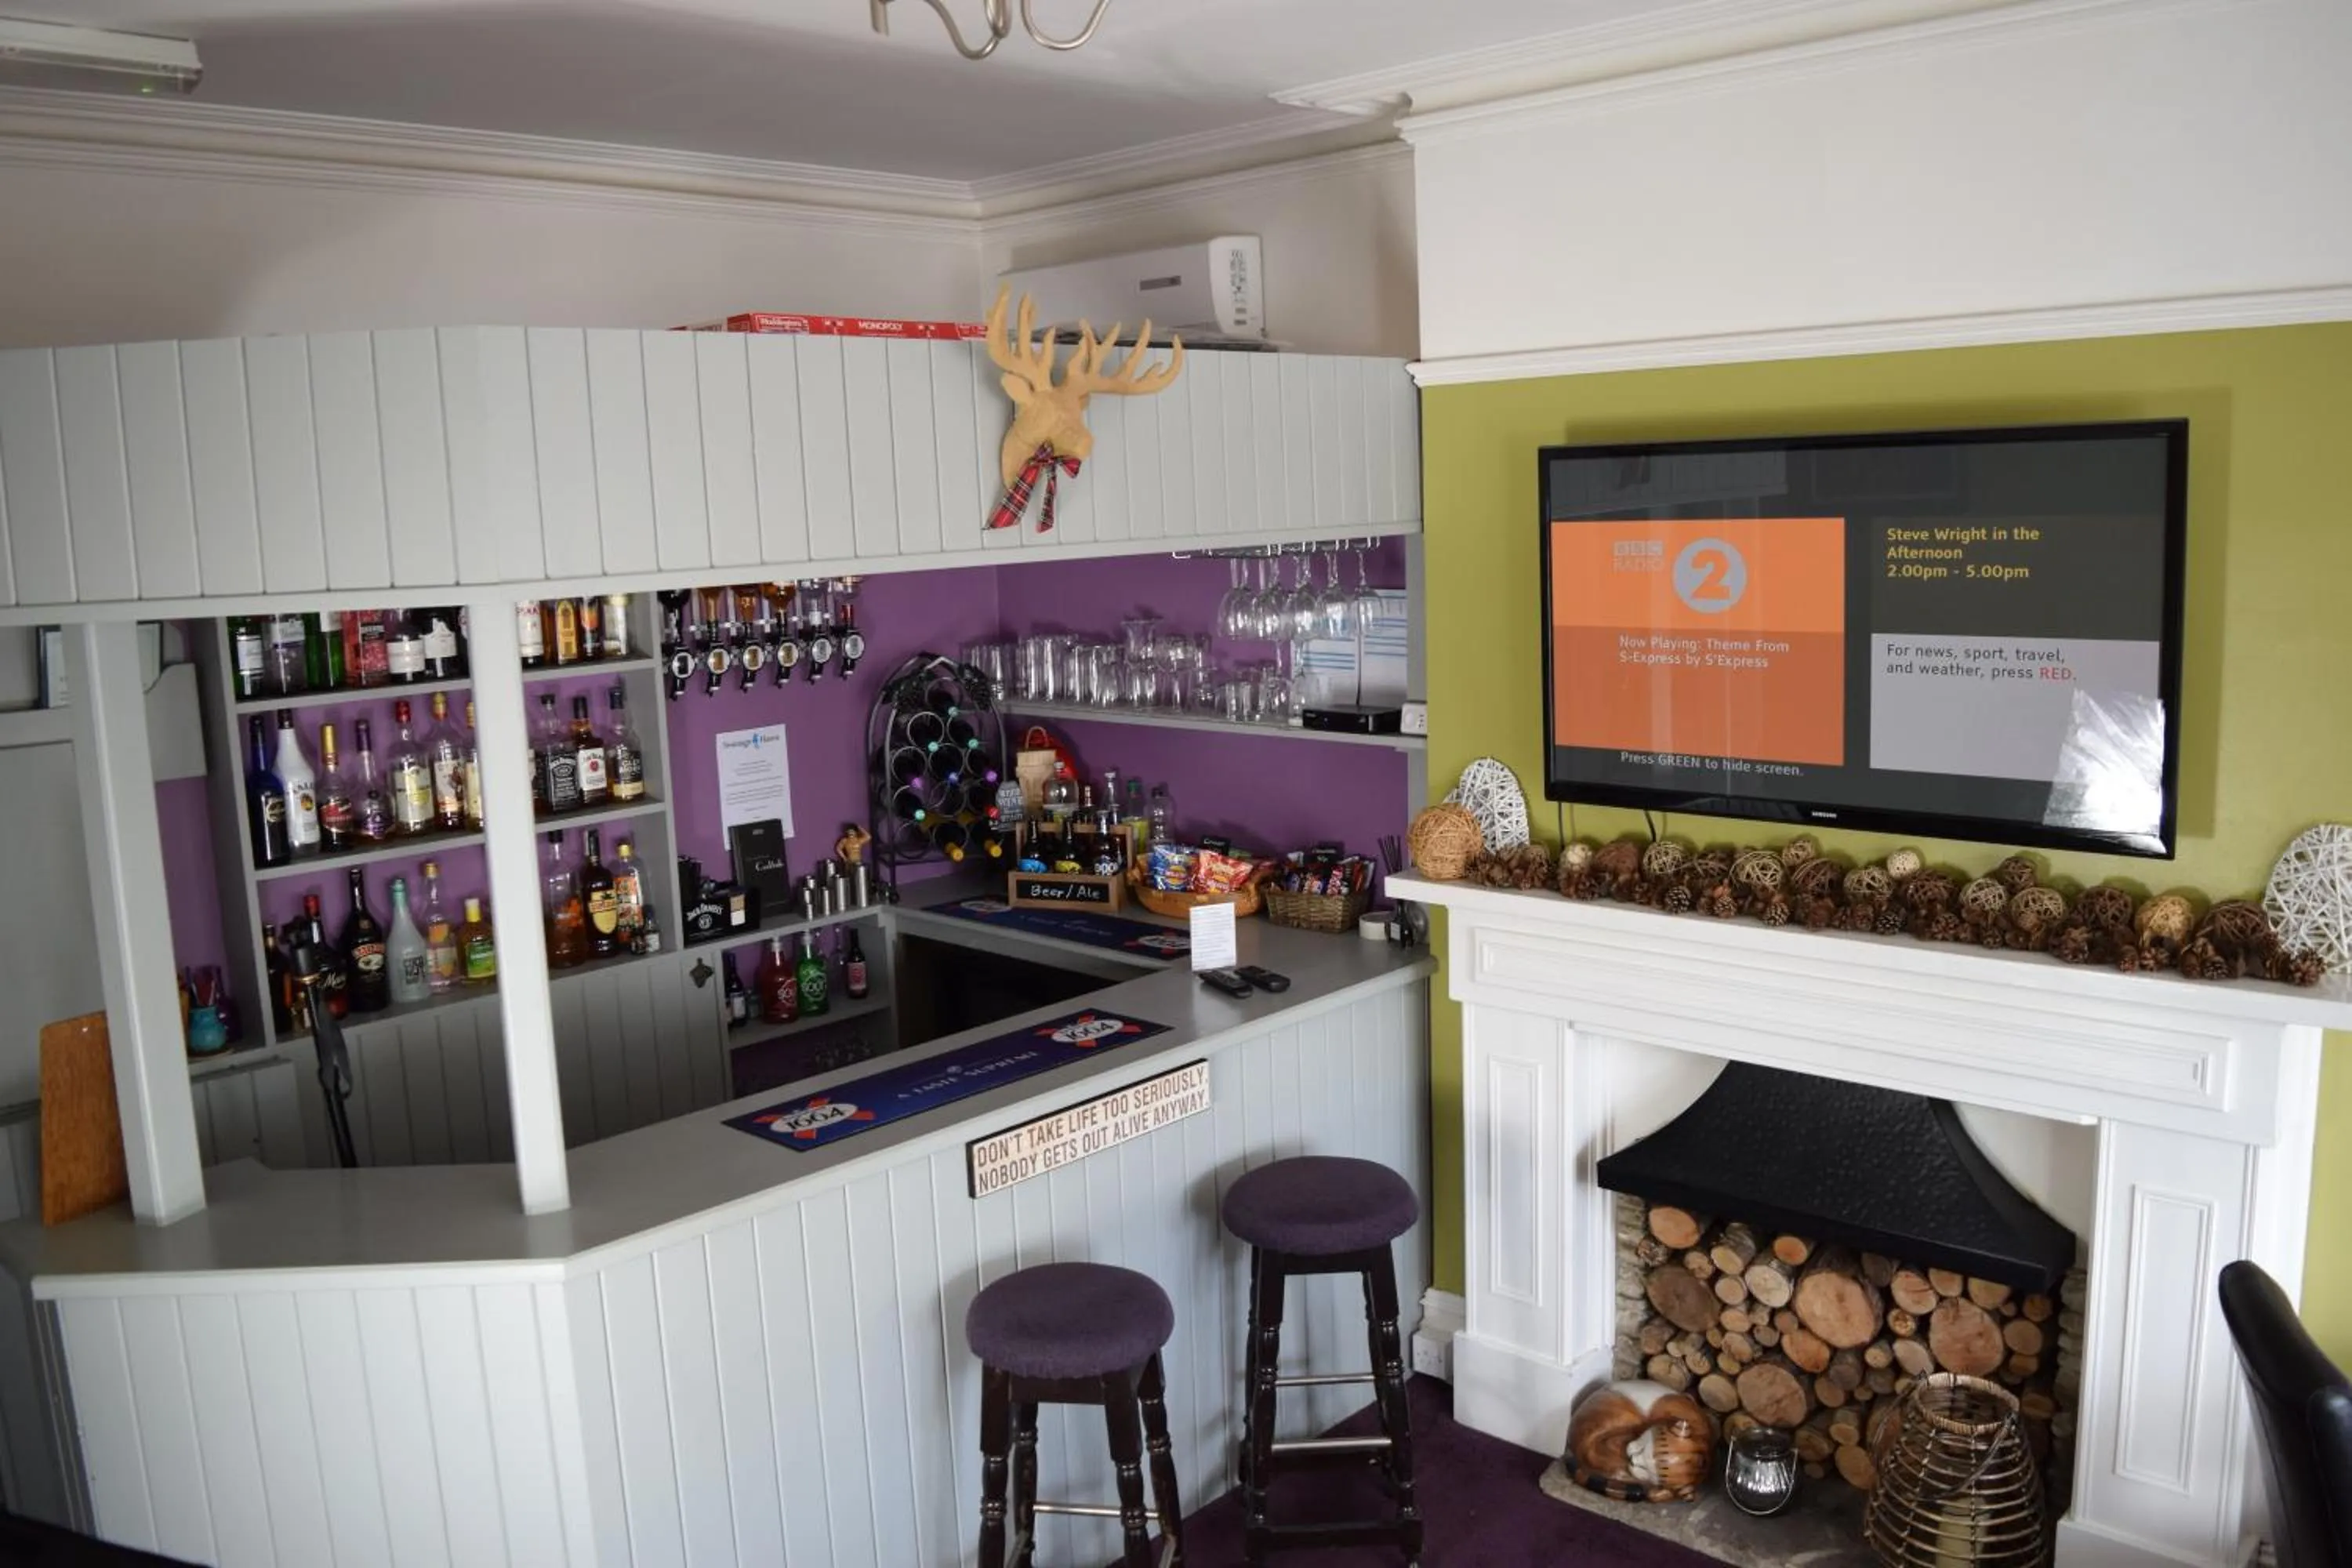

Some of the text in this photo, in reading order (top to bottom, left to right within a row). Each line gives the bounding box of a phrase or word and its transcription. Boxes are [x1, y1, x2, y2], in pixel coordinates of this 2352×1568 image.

[1886, 526, 2040, 544] Steve Wright in the
[1886, 545, 1963, 560] Afternoon
[1690, 547, 1732, 601] 2
[1886, 564, 1947, 582] 2.00pm
[1965, 564, 2030, 582] 5.00pm
[1619, 635, 1790, 653] Now Playing: Theme From
[1886, 644, 2065, 663] For news, sport, travel,
[1619, 652, 1681, 666] S-Express
[1686, 654, 1701, 667] by
[1886, 661, 2077, 681] and weather, press RED.
[1621, 751, 1804, 776] Press GREEN to hide screen.
[978, 1133, 1023, 1167] DON'T
[1027, 1117, 1064, 1149] TAKE
[1069, 1106, 1098, 1132] LIFE
[1102, 1094, 1128, 1120] TOO
[978, 1153, 1037, 1193] NOBODY
[1044, 1138, 1078, 1168] GETS
[1083, 1126, 1108, 1152] OUT
[1113, 1111, 1149, 1142] ALIVE
